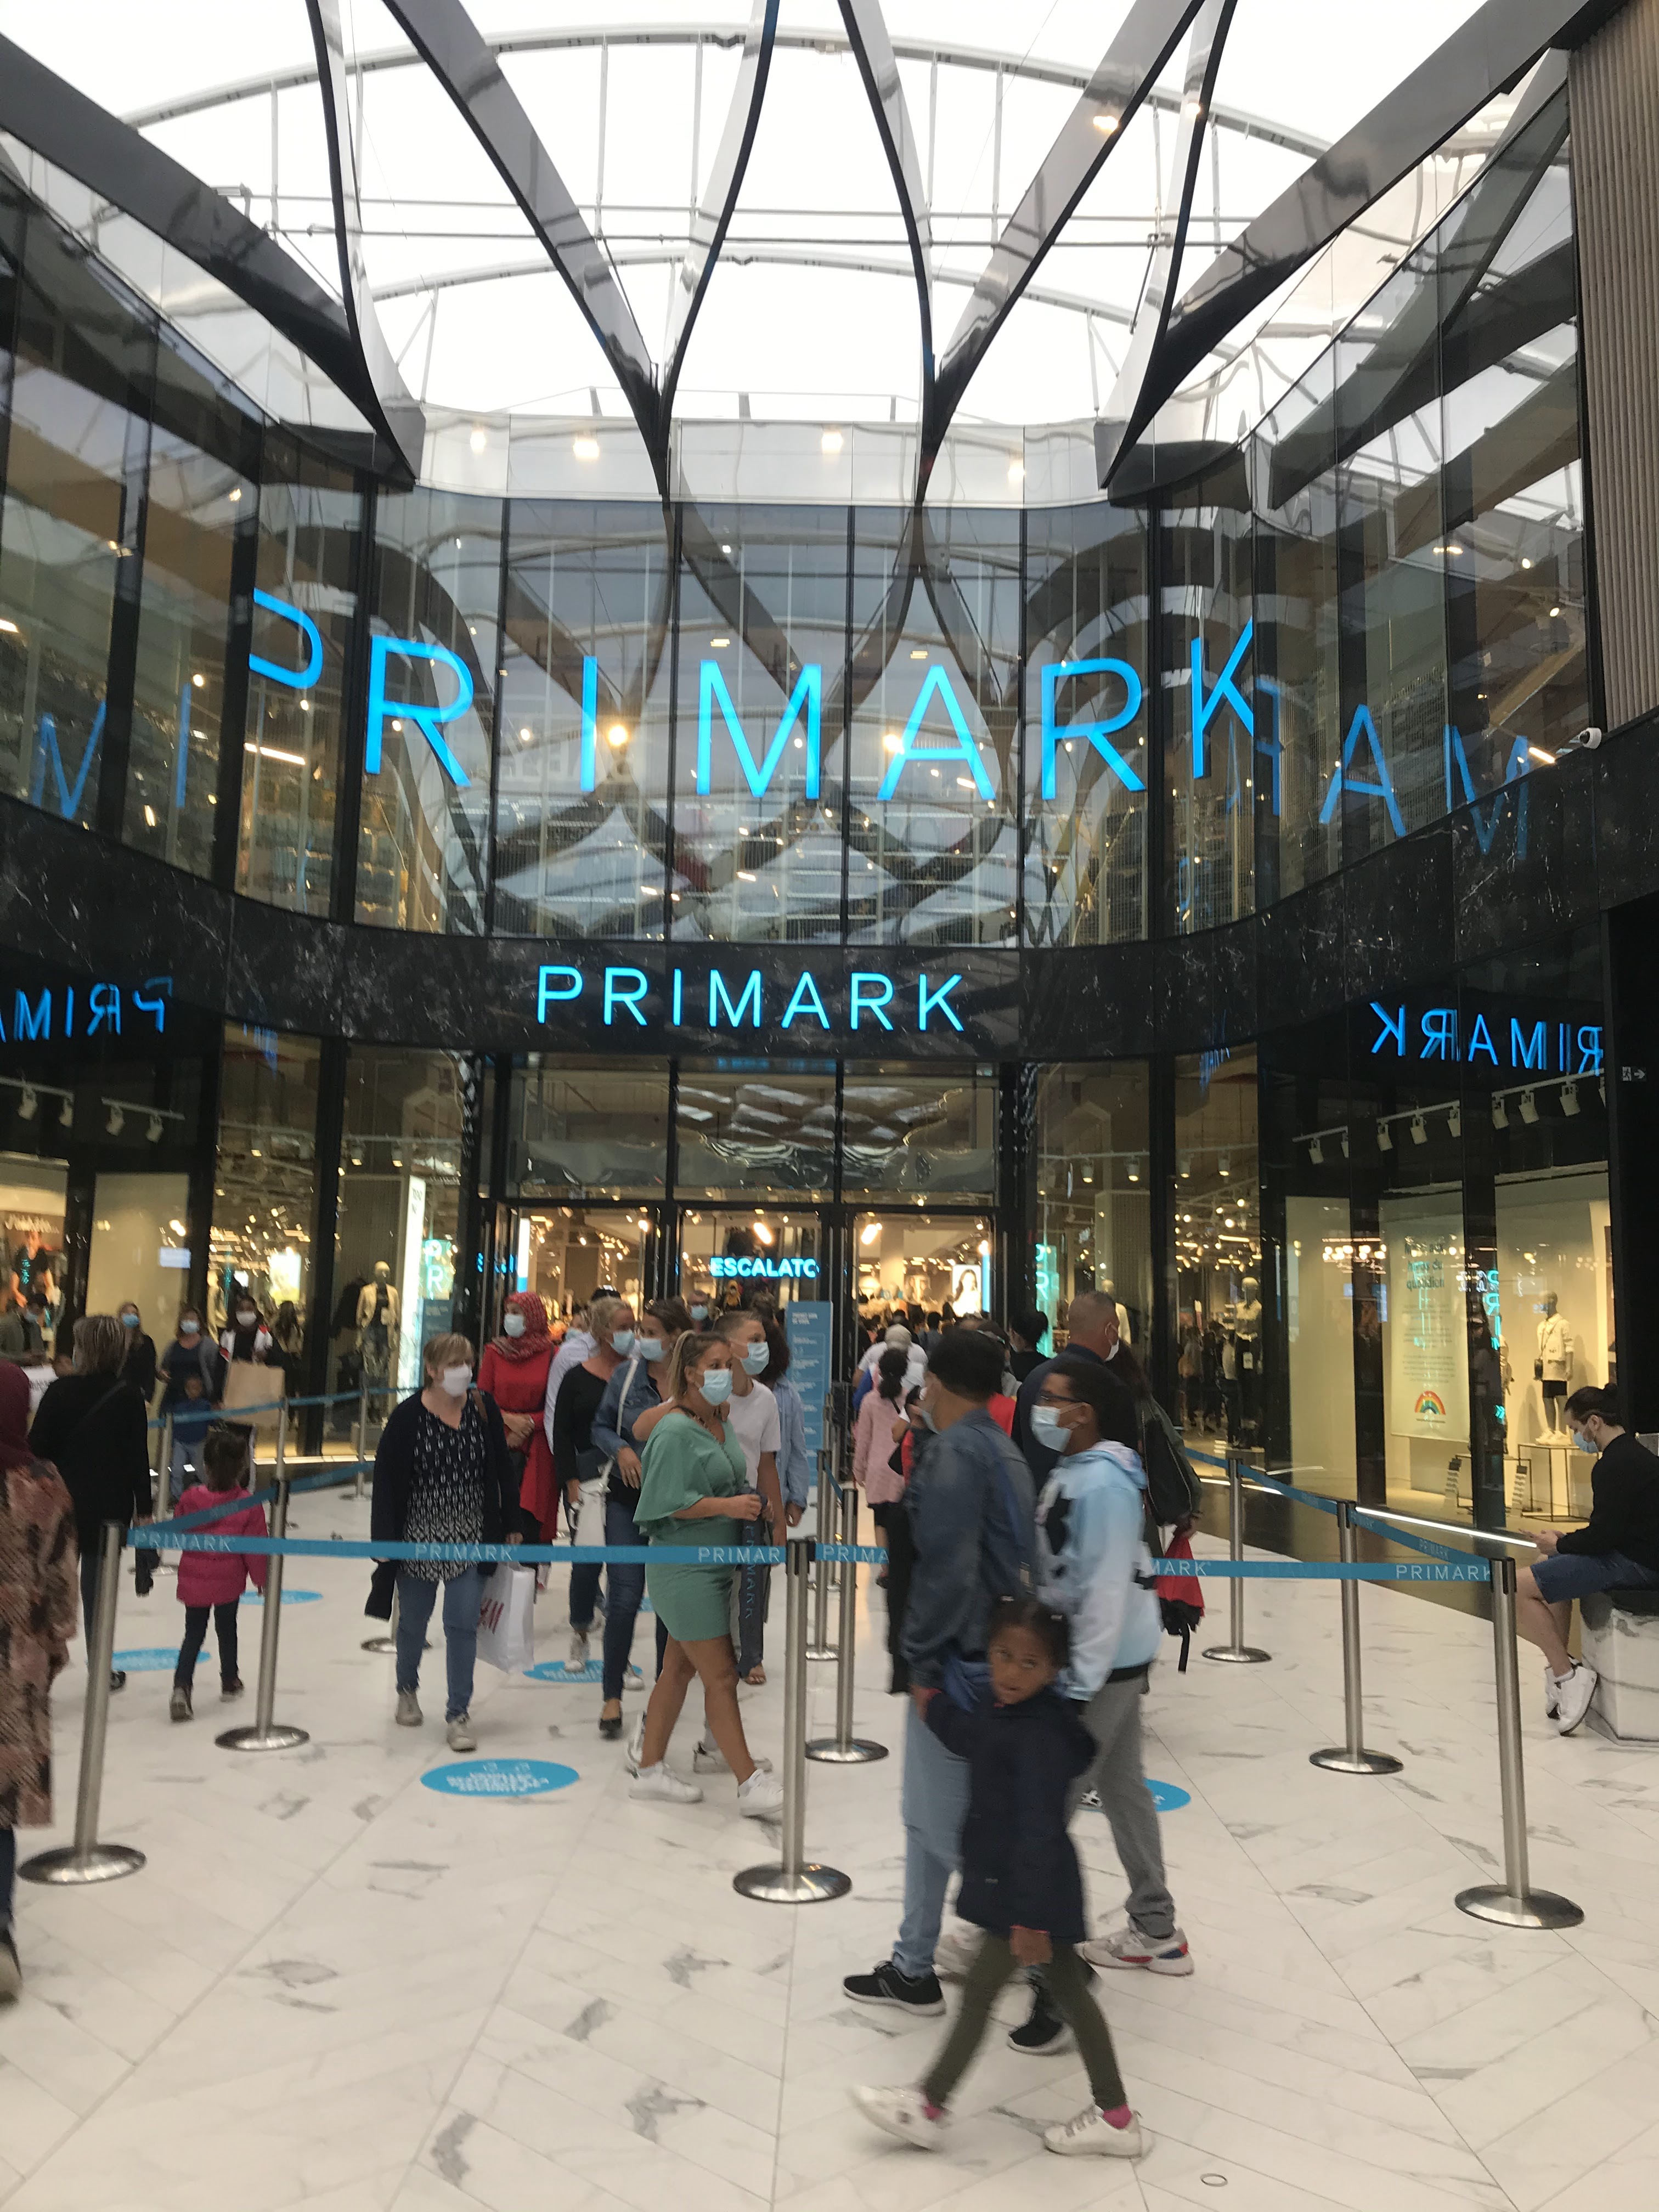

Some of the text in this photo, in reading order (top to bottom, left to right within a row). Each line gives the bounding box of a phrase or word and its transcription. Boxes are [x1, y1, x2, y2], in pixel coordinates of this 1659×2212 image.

[249, 588, 1254, 800] PRIMARK
[537, 964, 964, 1032] PRIMARK
[135, 1533, 233, 1552] PRIMARK
[415, 1543, 512, 1561] PRIMARK
[698, 1547, 781, 1563] PRIMAR
